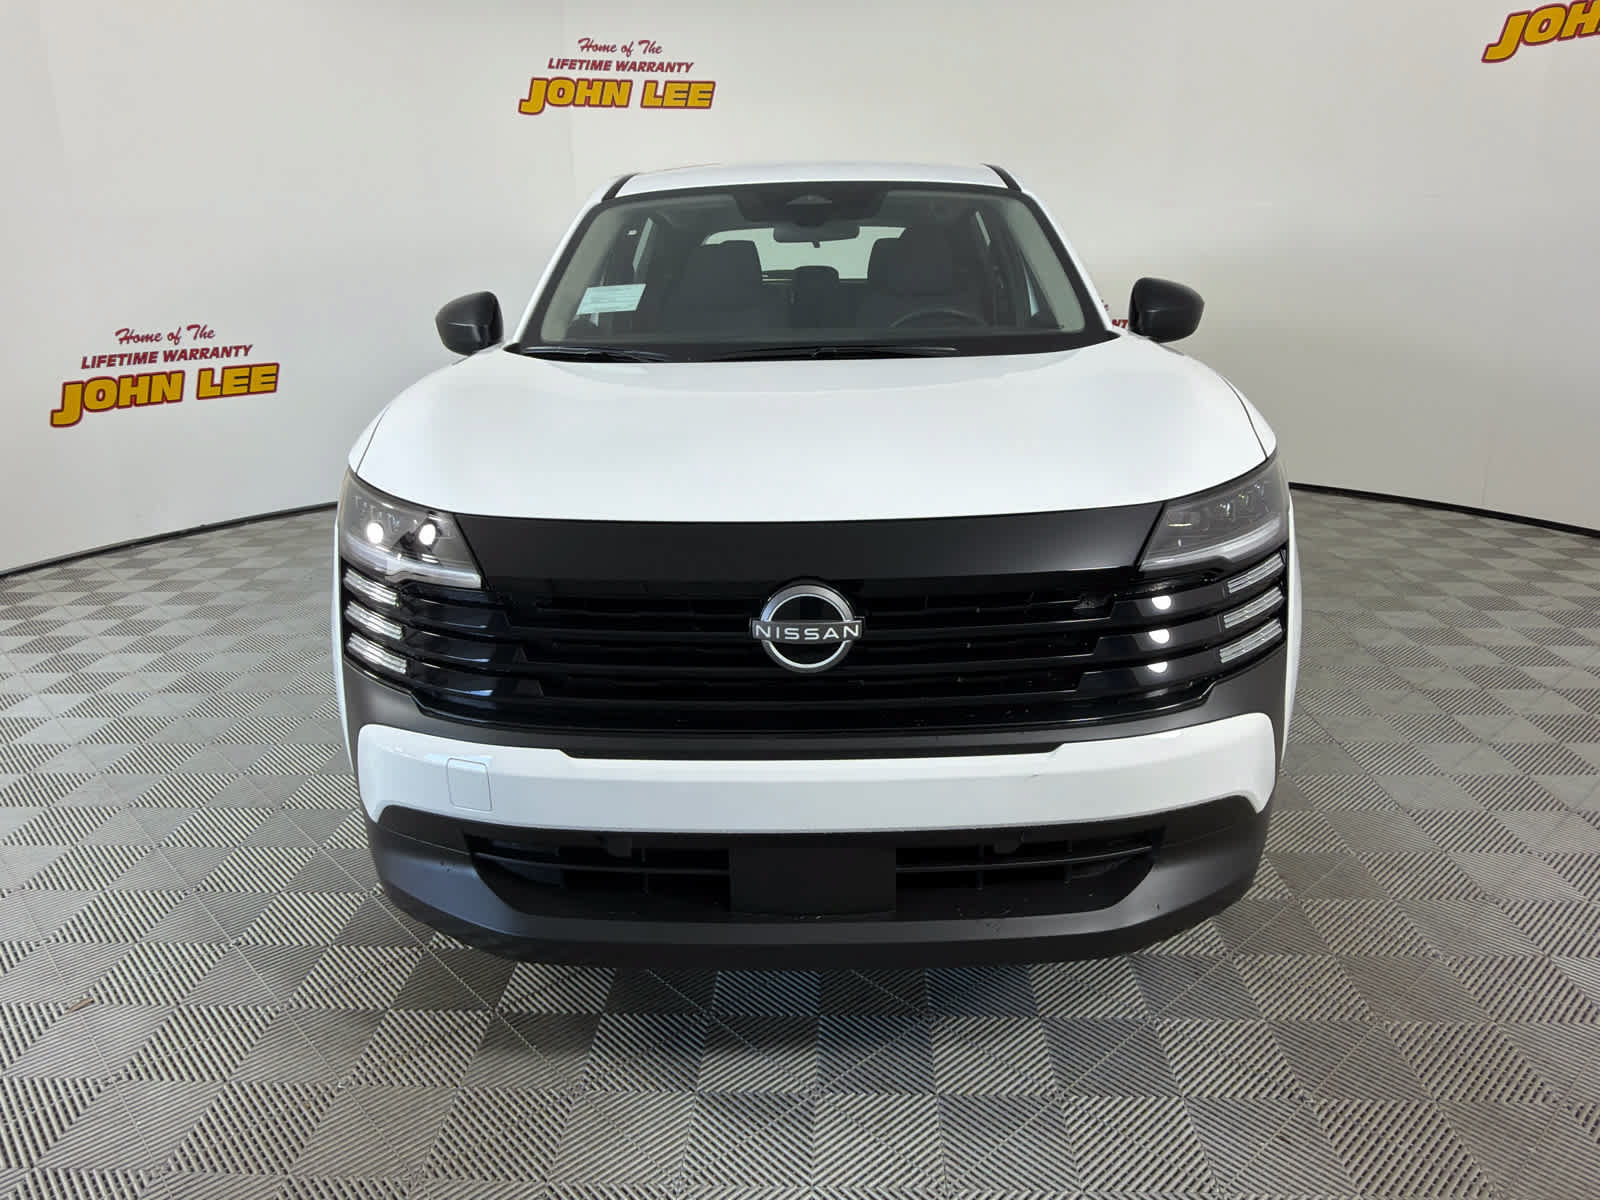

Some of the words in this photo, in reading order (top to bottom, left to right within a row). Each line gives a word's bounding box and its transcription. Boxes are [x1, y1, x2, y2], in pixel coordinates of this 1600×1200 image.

[1481, 0, 1600, 63] JOH
[577, 37, 618, 54] Home
[621, 41, 634, 57] of
[638, 39, 663, 55] The
[547, 58, 613, 72] LIFETIME
[615, 60, 694, 73] WARRANTY
[518, 76, 633, 116] JOHN
[640, 79, 716, 109] LEE
[115, 327, 163, 345] Home
[167, 326, 182, 346] of
[186, 323, 216, 341] The
[80, 350, 159, 370] LIFETIME
[163, 344, 254, 363] WARRANTY
[50, 369, 186, 428] JOHN
[196, 362, 280, 401] LEE
[755, 624, 859, 640] NISSAN
